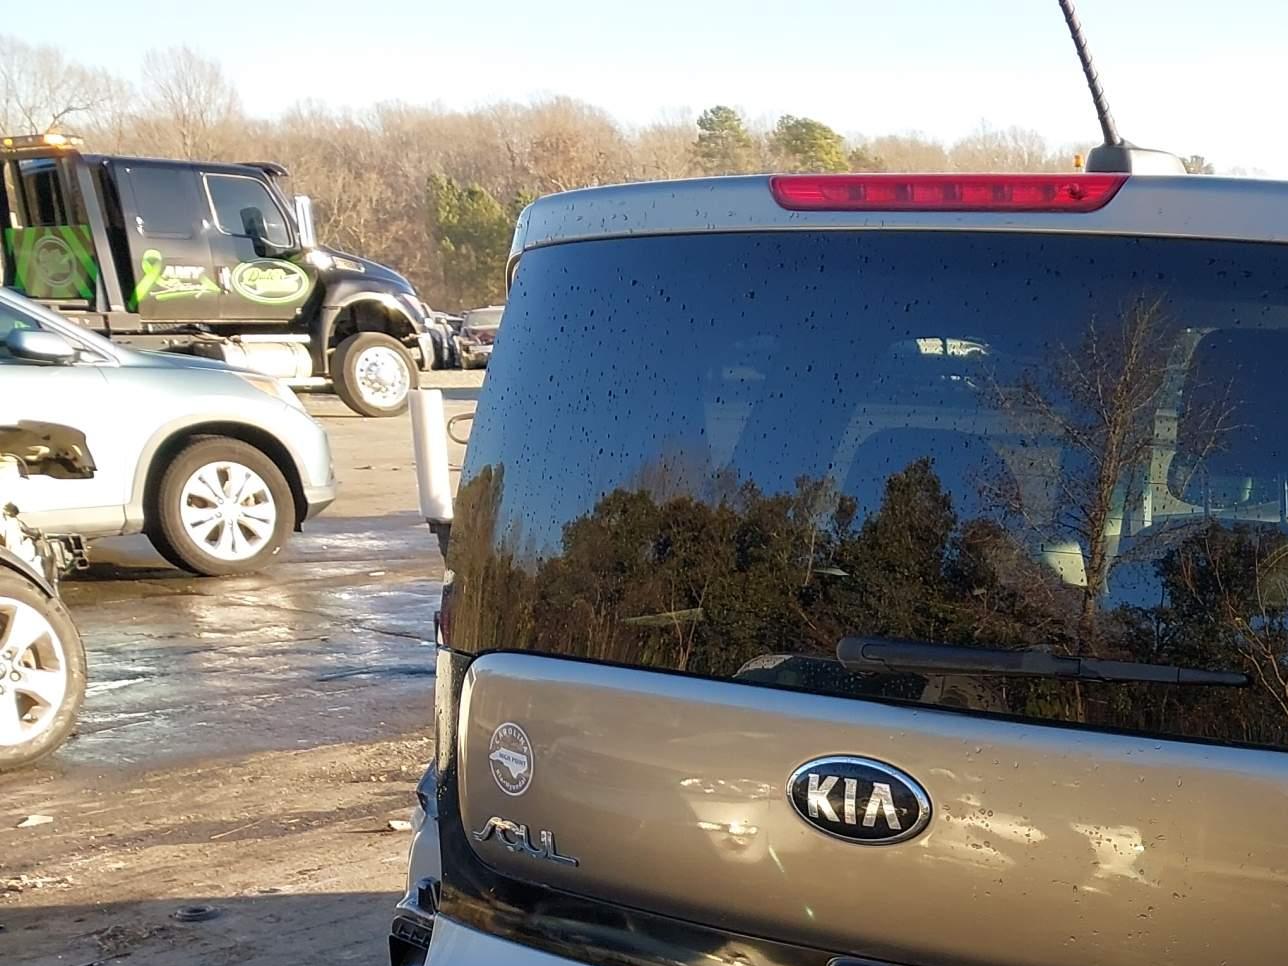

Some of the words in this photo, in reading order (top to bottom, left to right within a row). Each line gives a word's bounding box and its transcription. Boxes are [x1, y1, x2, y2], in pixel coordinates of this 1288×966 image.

[494, 727, 528, 753] CAROLINA
[807, 773, 902, 830] KIA
[473, 816, 578, 865] SOUL
